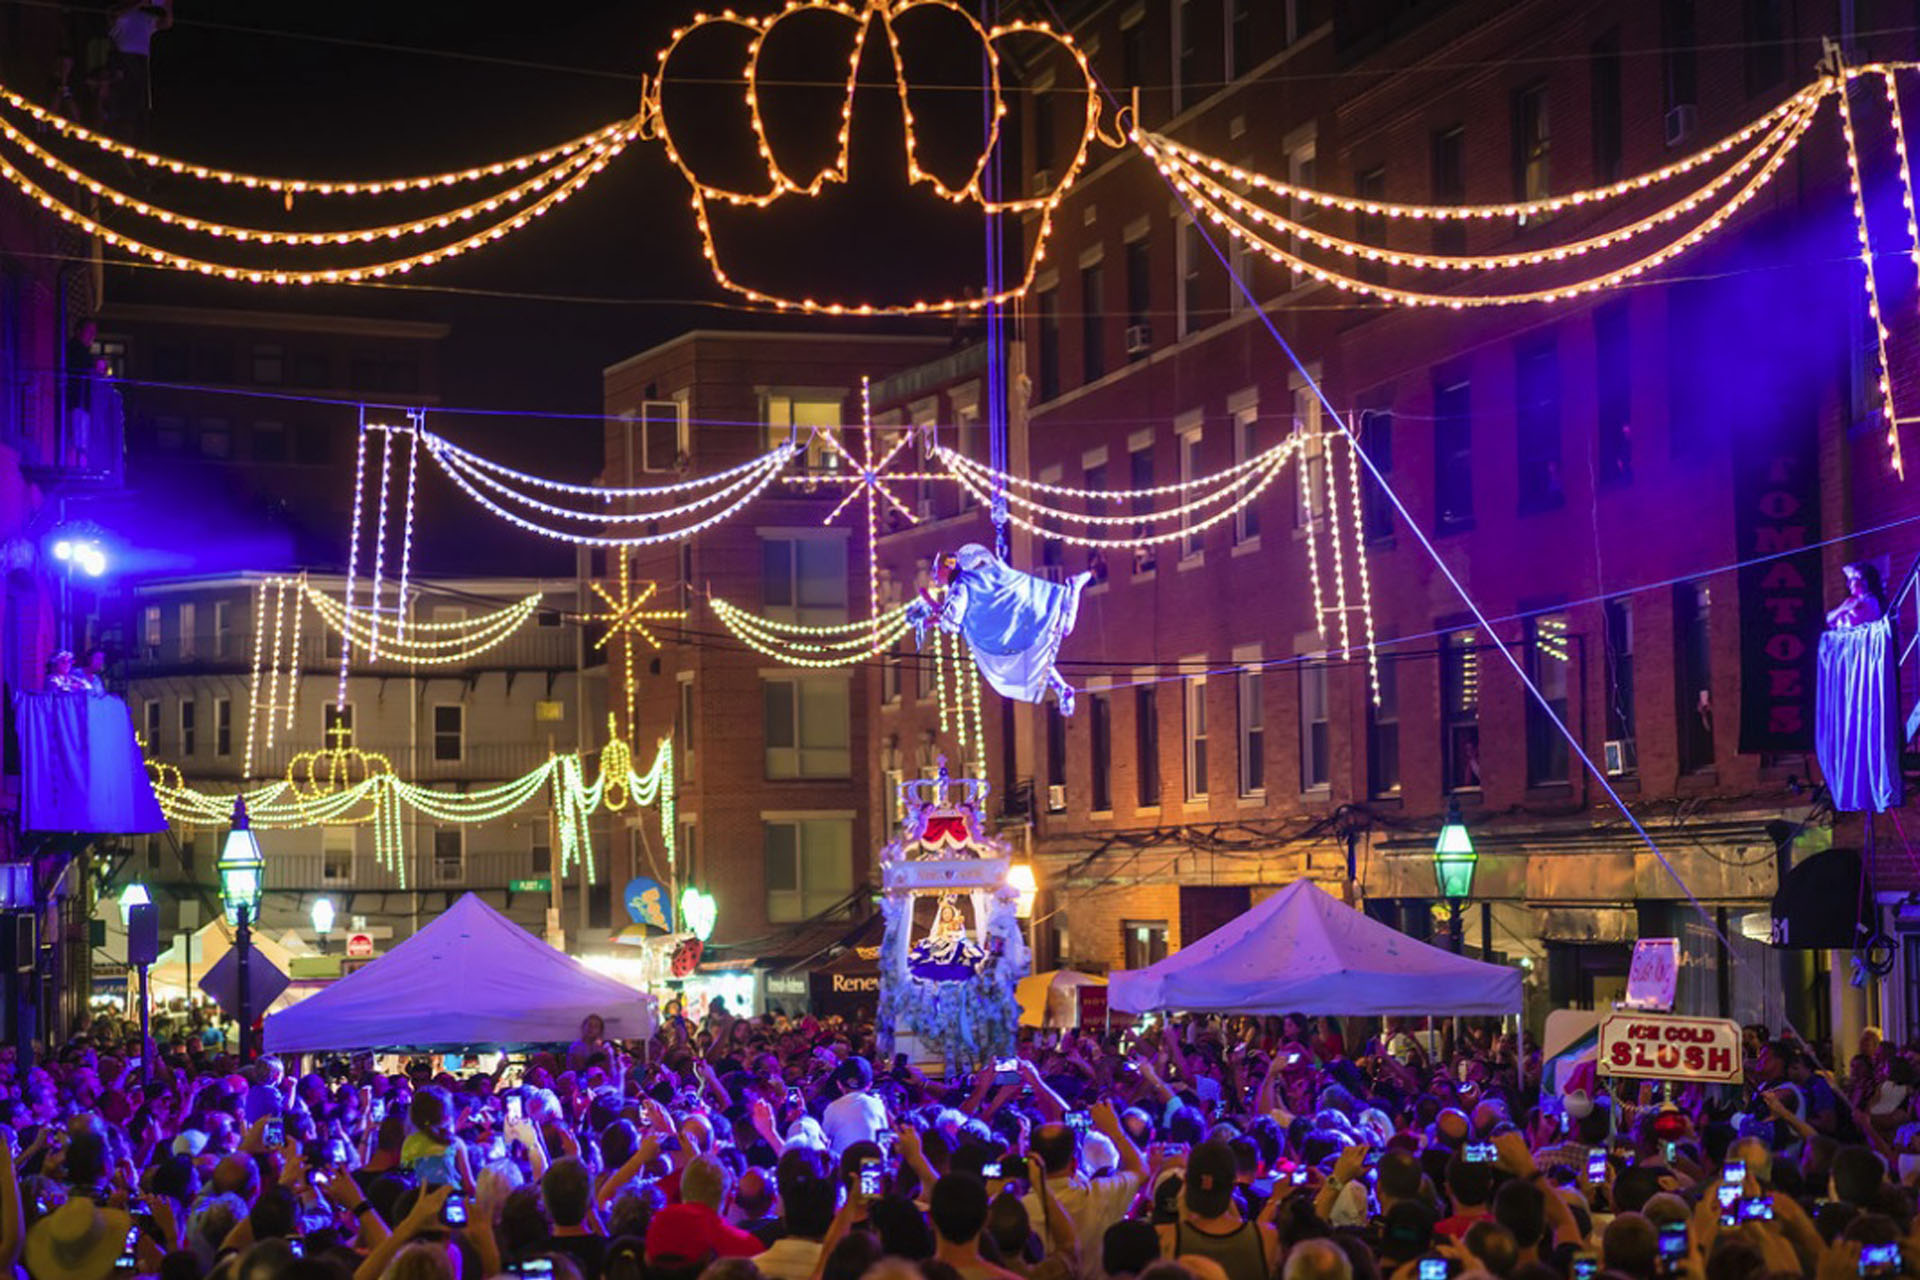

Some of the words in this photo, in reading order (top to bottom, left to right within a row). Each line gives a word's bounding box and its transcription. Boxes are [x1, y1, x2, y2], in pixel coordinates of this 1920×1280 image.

[1754, 456, 1806, 733] TOMATOES
[1627, 1024, 1660, 1041] ICE
[1664, 1026, 1715, 1043] COLD
[1610, 1041, 1731, 1072] SLUSH
